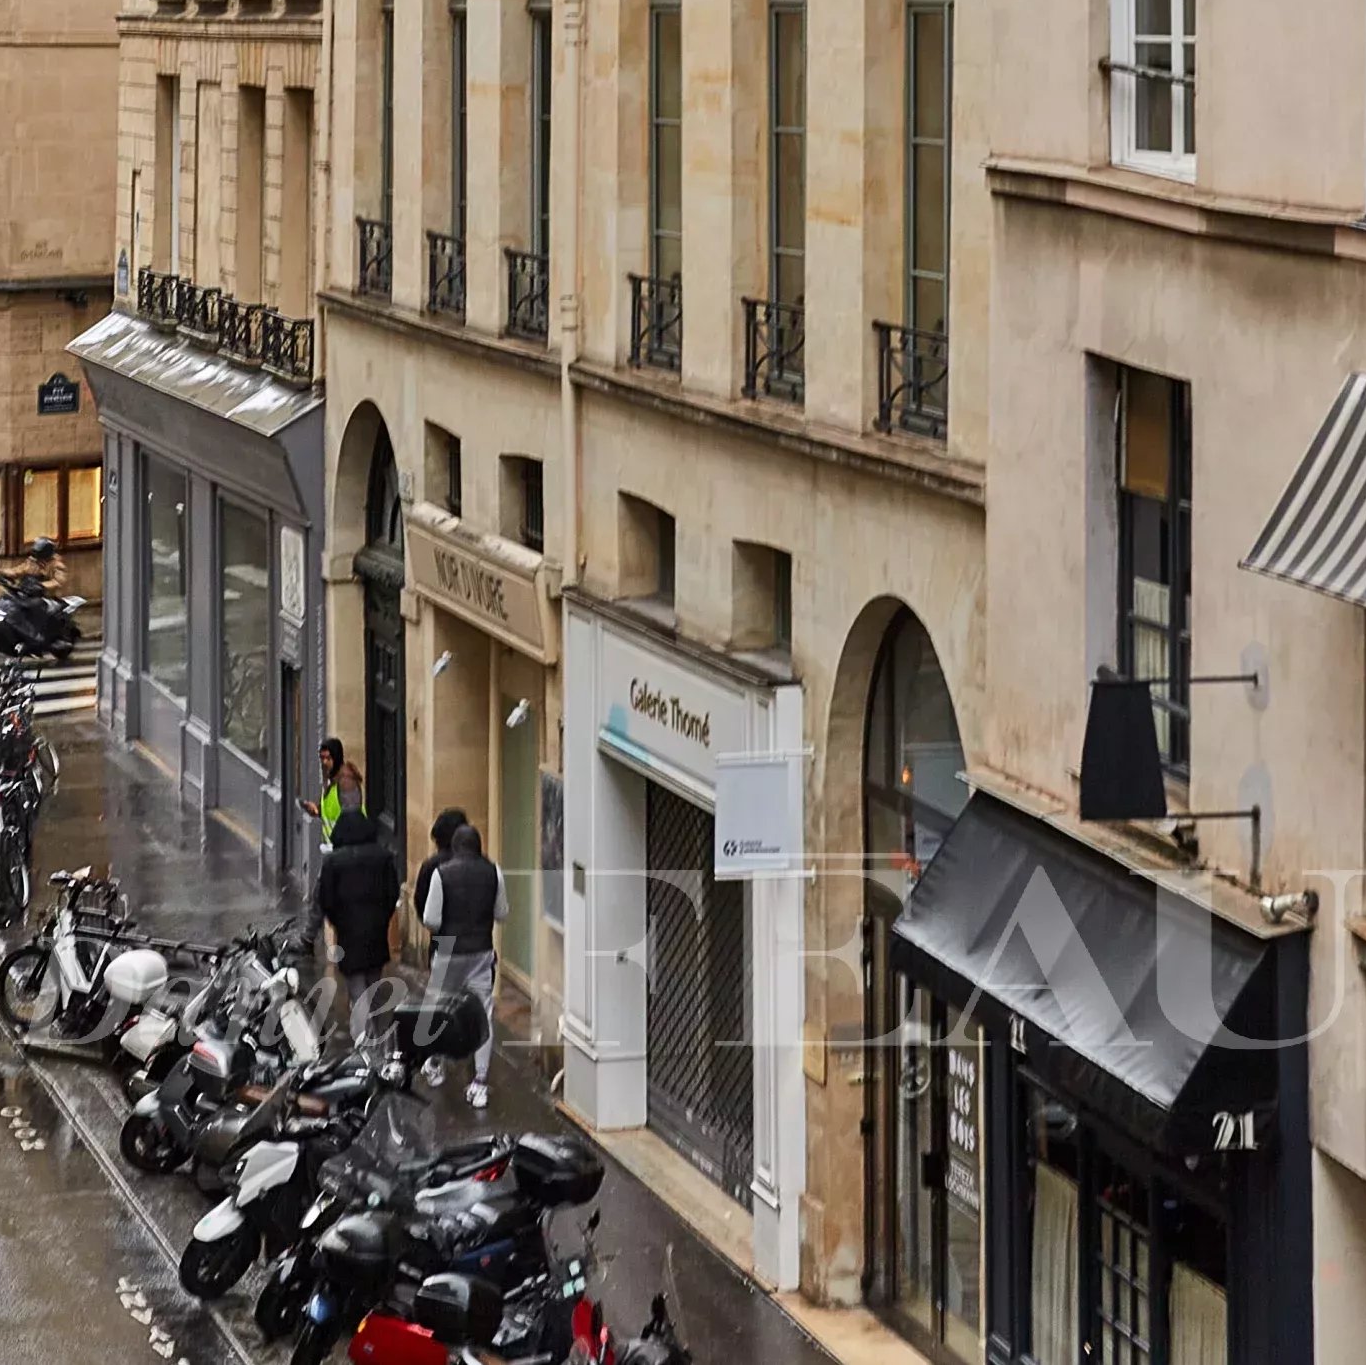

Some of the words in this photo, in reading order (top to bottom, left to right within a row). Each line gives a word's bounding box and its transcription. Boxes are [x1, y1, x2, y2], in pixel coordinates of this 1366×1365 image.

[630, 678, 667, 727] Galerie
[669, 697, 710, 749] Thomé
[1212, 1111, 1258, 1151] 21
